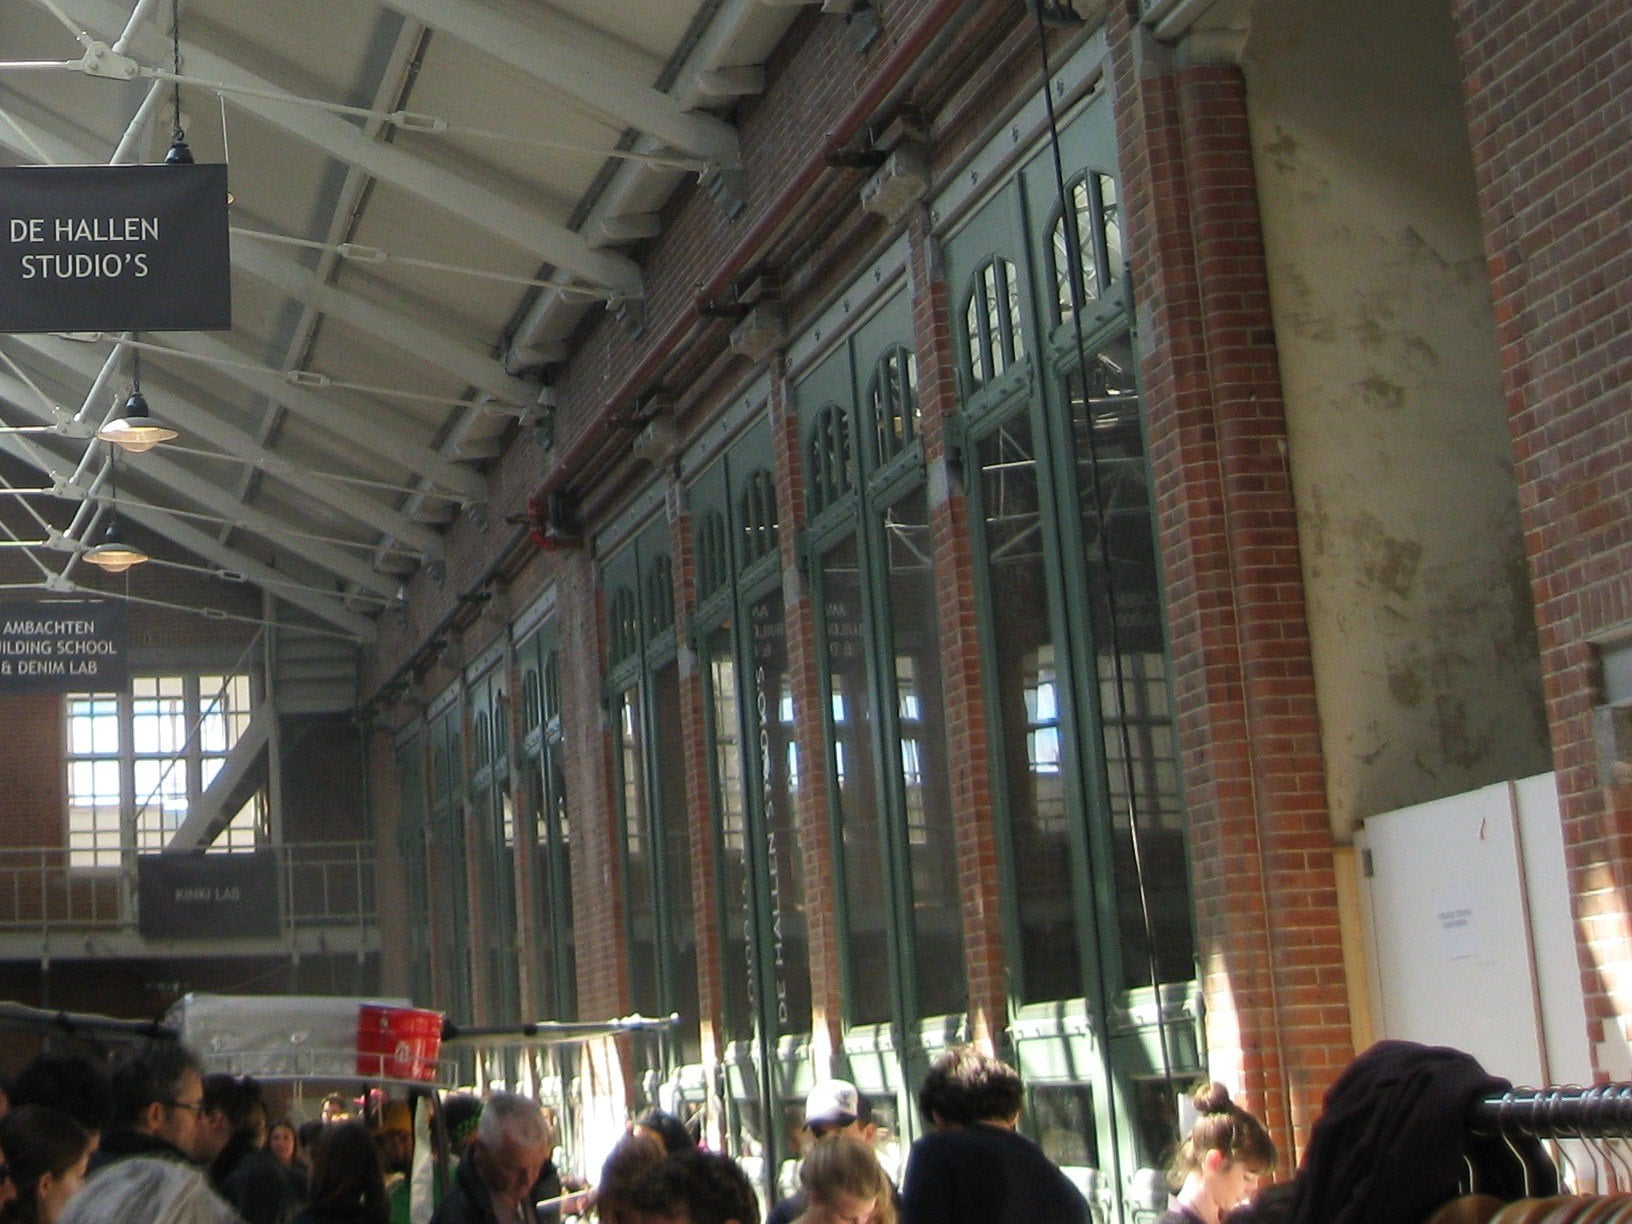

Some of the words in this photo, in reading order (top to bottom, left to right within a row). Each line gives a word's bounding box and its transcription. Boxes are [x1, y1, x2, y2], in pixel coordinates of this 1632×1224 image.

[10, 219, 45, 243] DE
[55, 217, 159, 242] HALLEN
[21, 253, 148, 279] STUDIO'S
[2, 620, 95, 635] AMBACHTEN
[56, 640, 118, 655] SCHOOL
[0, 660, 13, 675] &
[18, 660, 66, 675] DENIM
[69, 660, 98, 675] LAB
